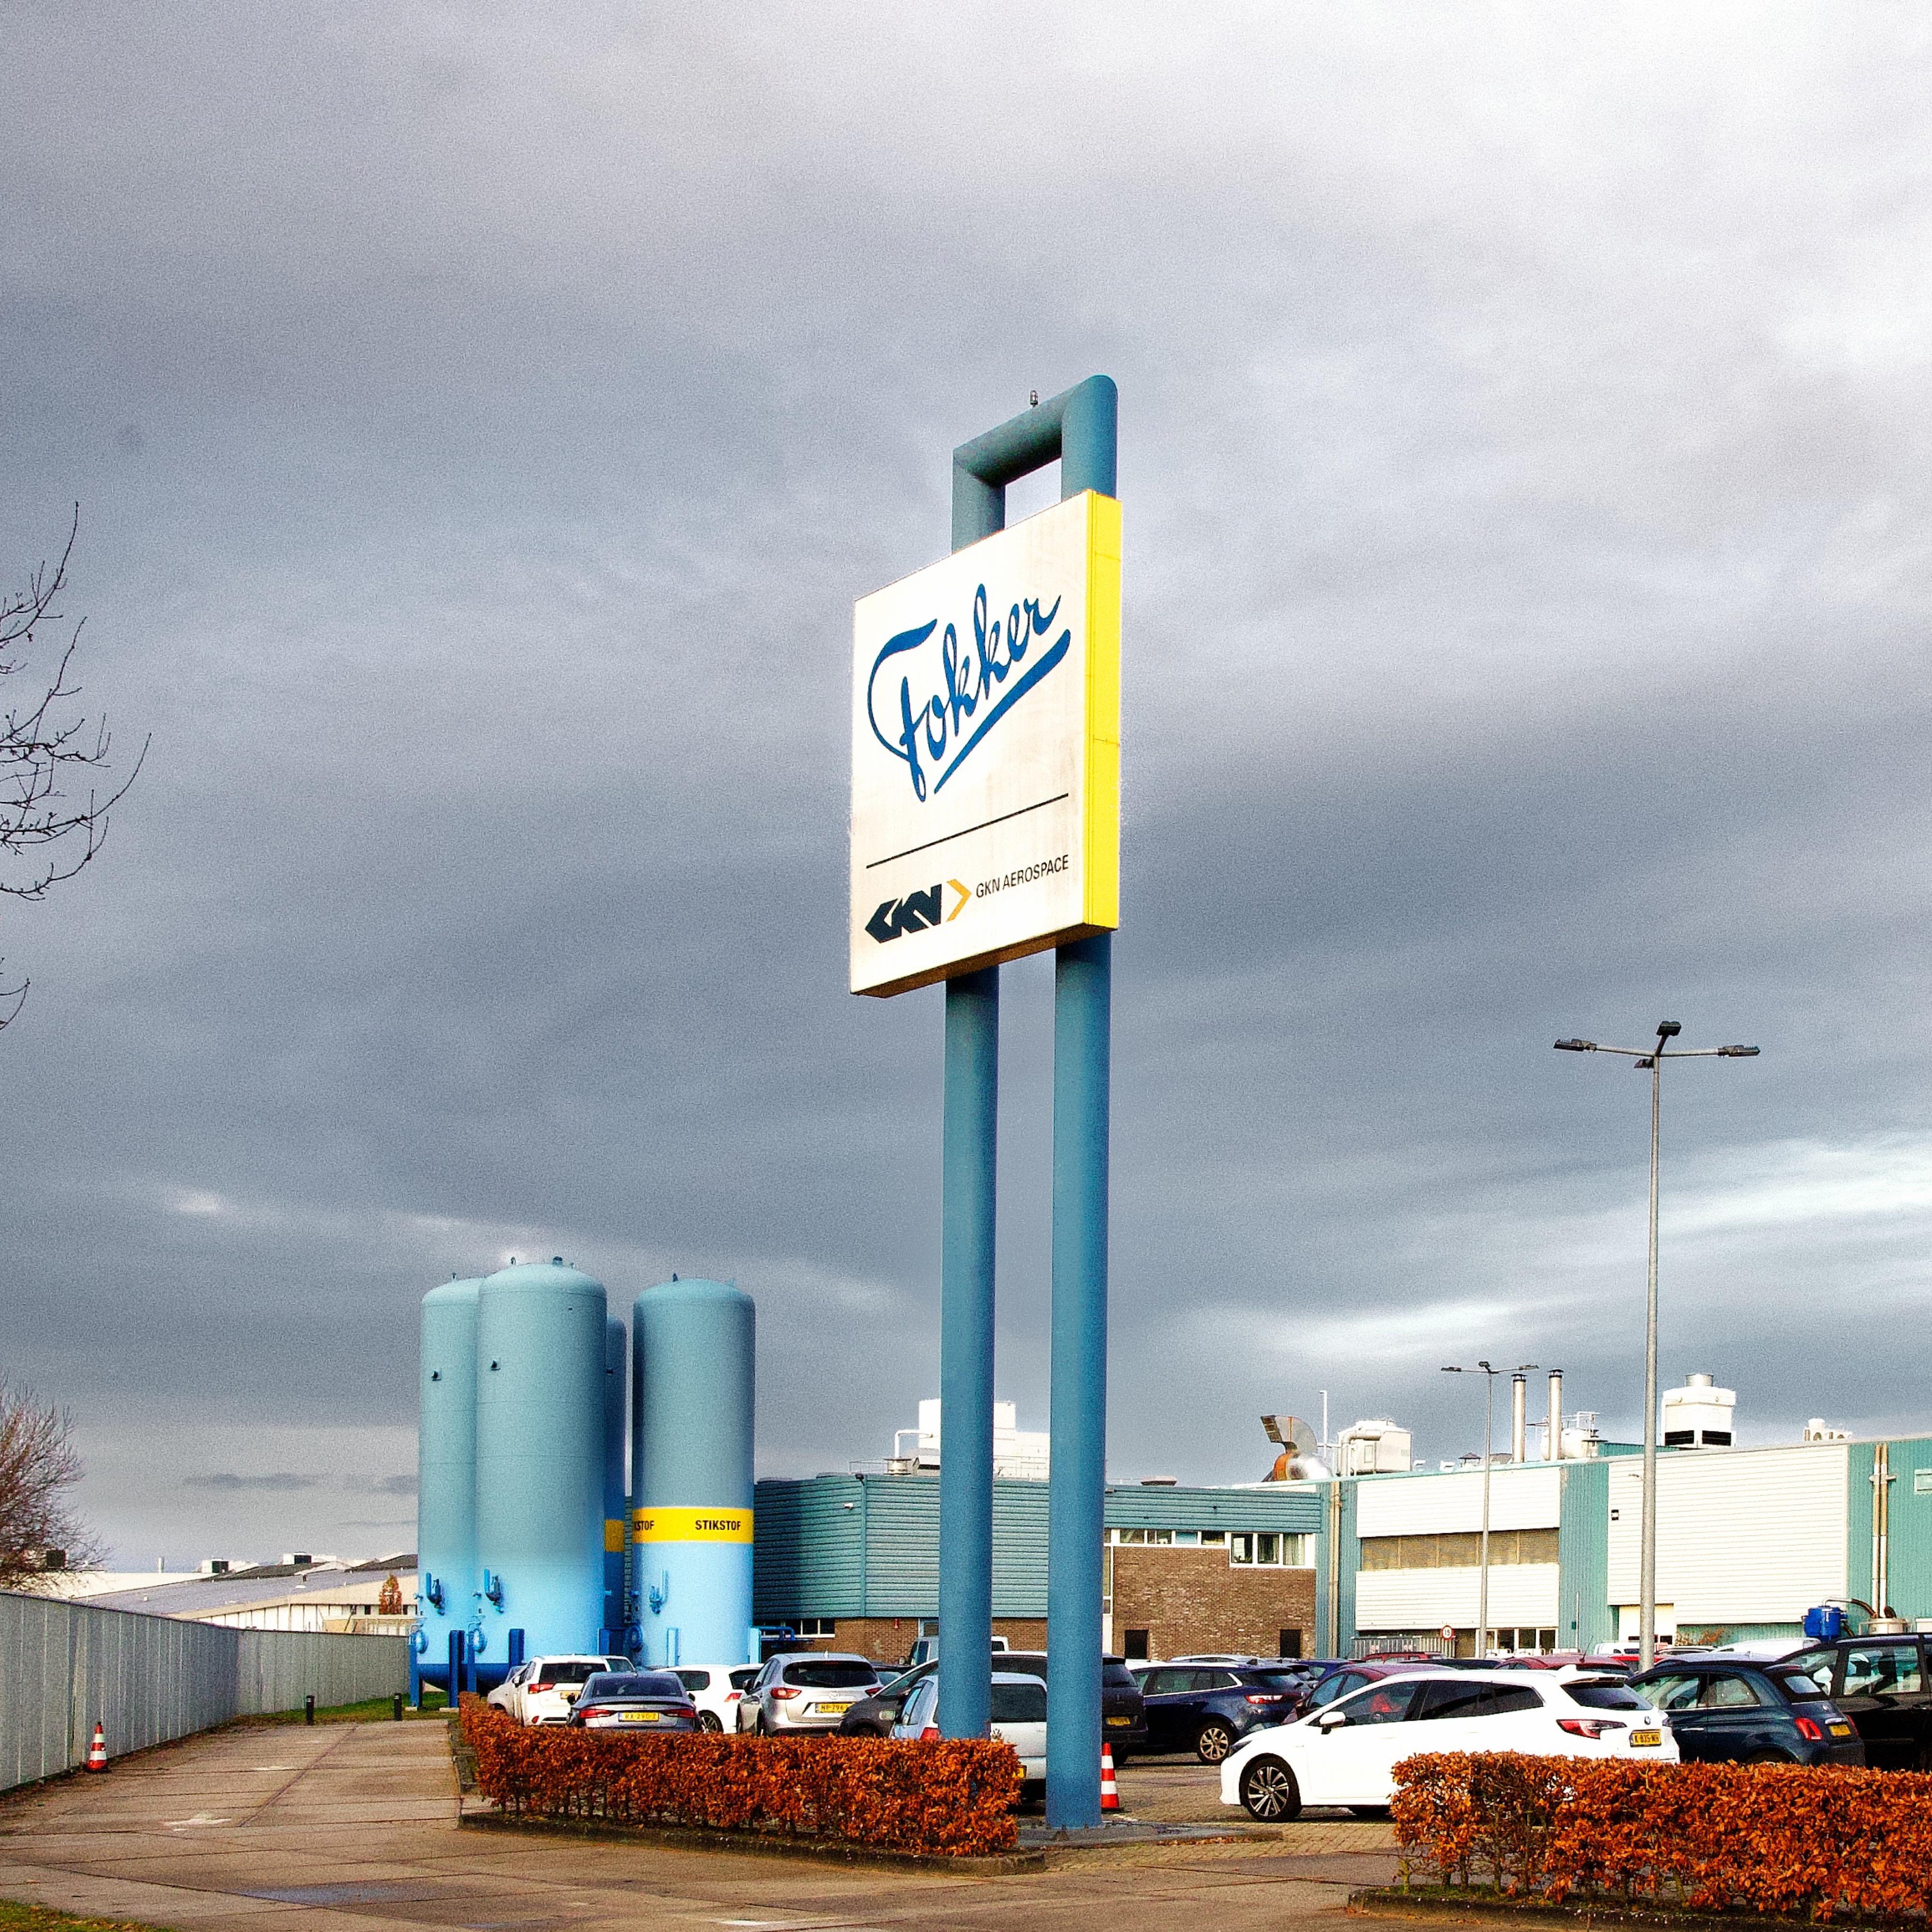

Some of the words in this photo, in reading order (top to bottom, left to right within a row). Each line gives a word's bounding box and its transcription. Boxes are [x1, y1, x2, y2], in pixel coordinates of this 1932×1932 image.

[868, 584, 1071, 802] Fokker
[976, 877, 1000, 898] GKN
[1002, 854, 1069, 889] AEROSPACE
[865, 884, 942, 944] GKN
[695, 1520, 741, 1531] STIKSTOF
